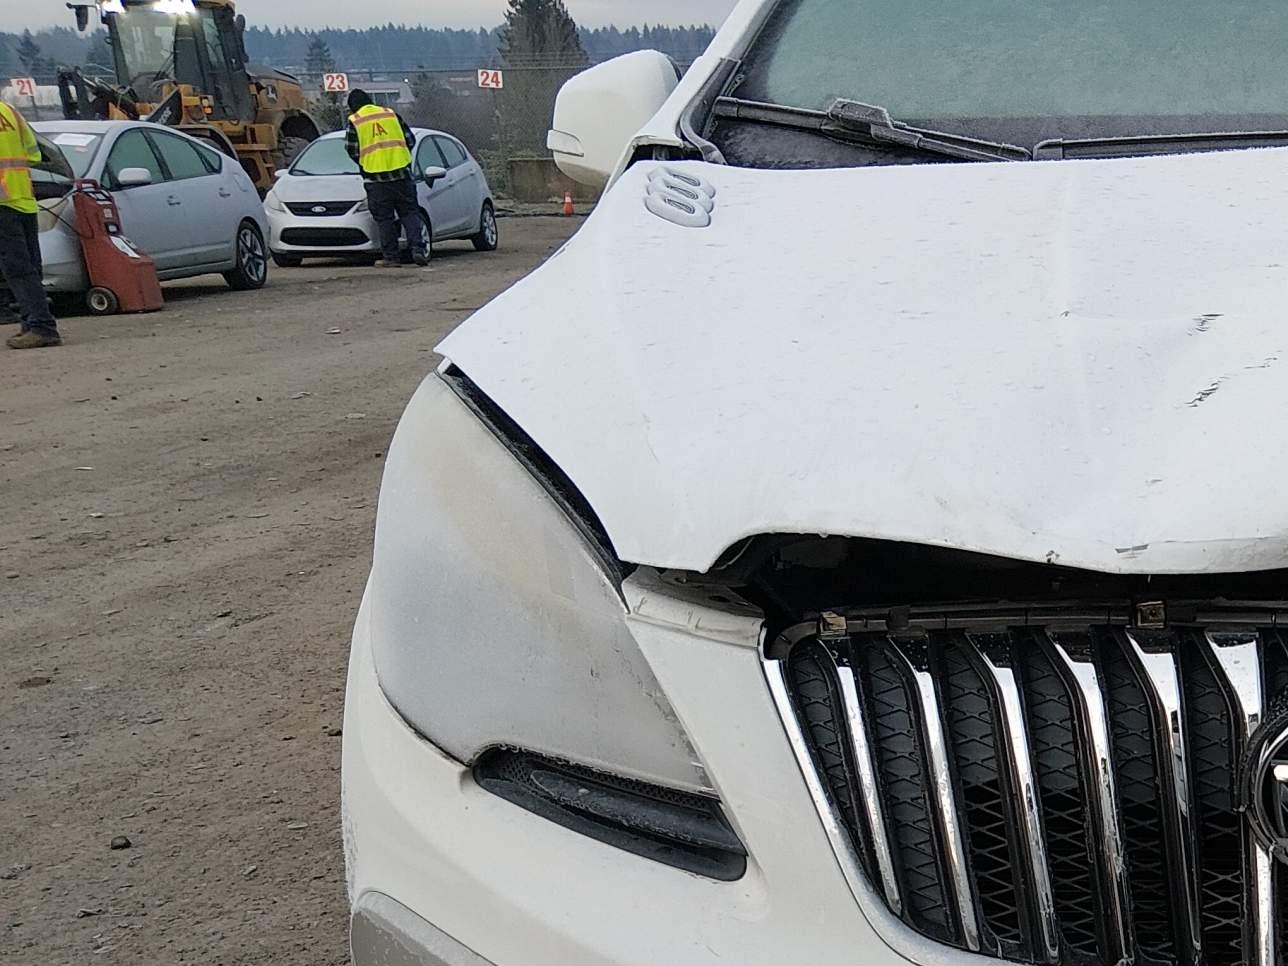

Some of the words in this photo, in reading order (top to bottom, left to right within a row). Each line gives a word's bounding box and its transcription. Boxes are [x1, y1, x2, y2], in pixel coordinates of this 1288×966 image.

[326, 74, 346, 90] 23
[480, 70, 501, 87] 24
[16, 79, 34, 96] 21
